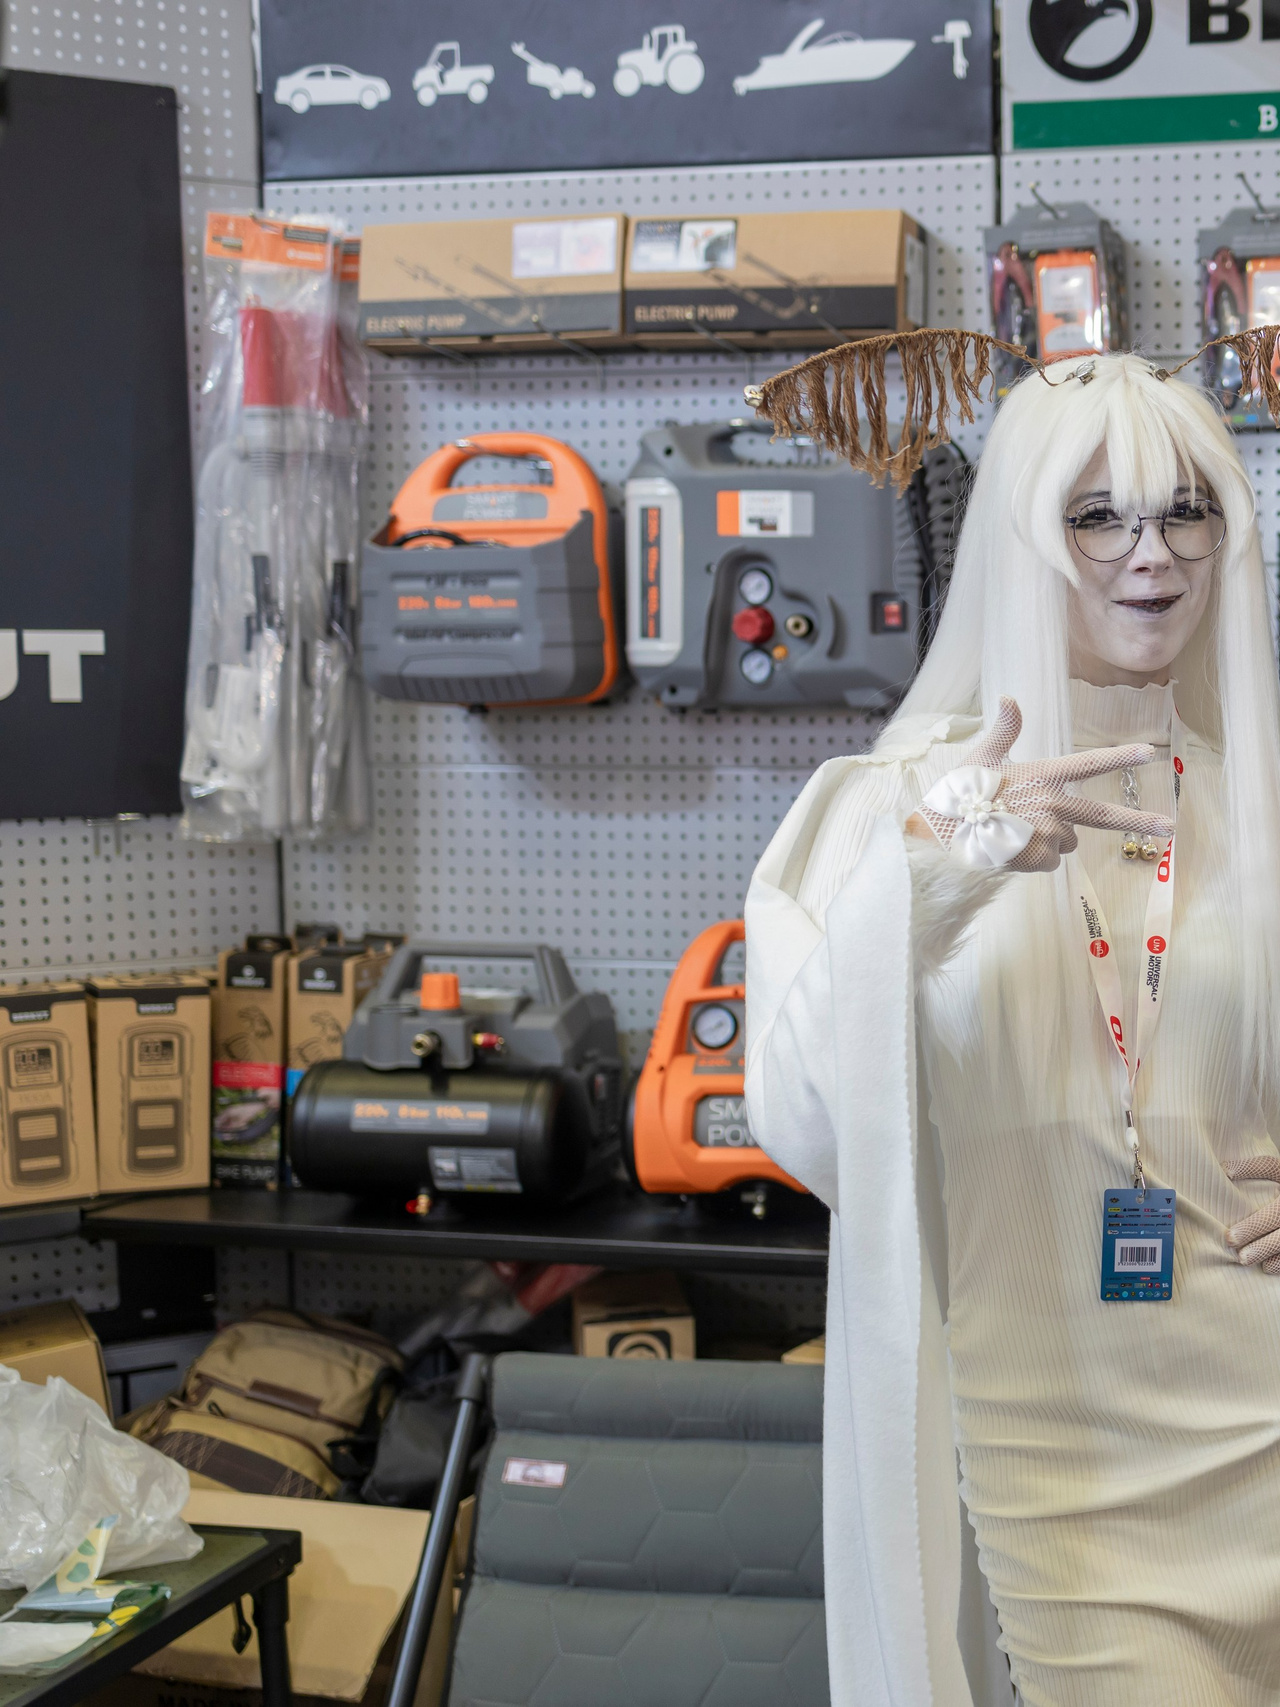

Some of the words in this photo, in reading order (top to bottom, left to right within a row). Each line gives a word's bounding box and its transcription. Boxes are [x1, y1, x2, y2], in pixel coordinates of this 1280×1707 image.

[366, 315, 425, 333] ELECTRIC
[427, 313, 466, 331] PUMP
[634, 304, 695, 323] ELECTRIC
[697, 304, 738, 321] PUMP
[1082, 900, 1097, 939] UNIVERSAL
[1153, 938, 1161, 952] UM
[1146, 955, 1155, 987] MOTORS
[1151, 956, 1162, 998] UNIVERSAL
